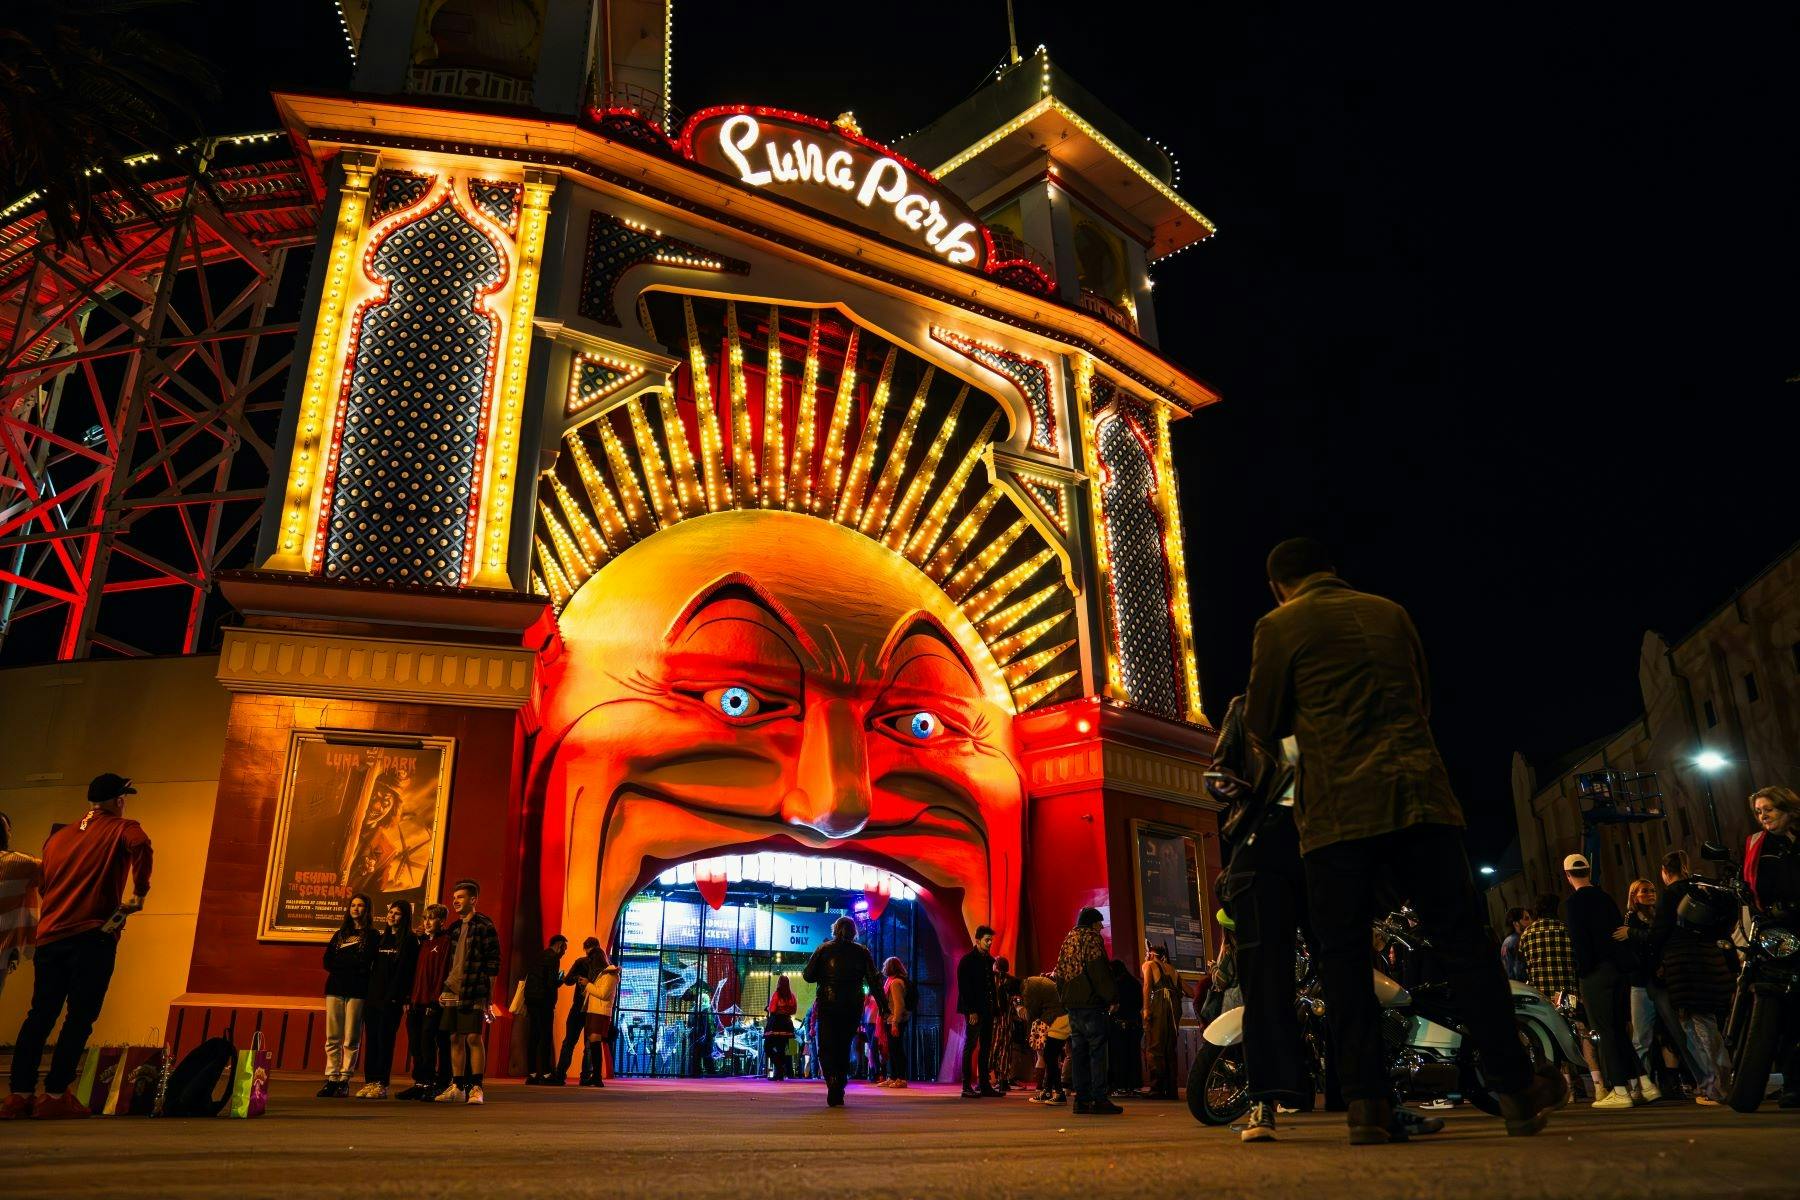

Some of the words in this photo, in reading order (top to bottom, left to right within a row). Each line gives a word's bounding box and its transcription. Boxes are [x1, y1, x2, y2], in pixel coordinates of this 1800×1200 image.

[719, 114, 855, 191] Luna
[856, 157, 977, 264] Park
[326, 752, 360, 771] LUNA
[295, 871, 337, 884] BEHIND
[288, 882, 299, 891] THE
[299, 885, 353, 898] SCREAMS
[790, 925, 809, 934] EXIT
[790, 936, 809, 945] ONLY
